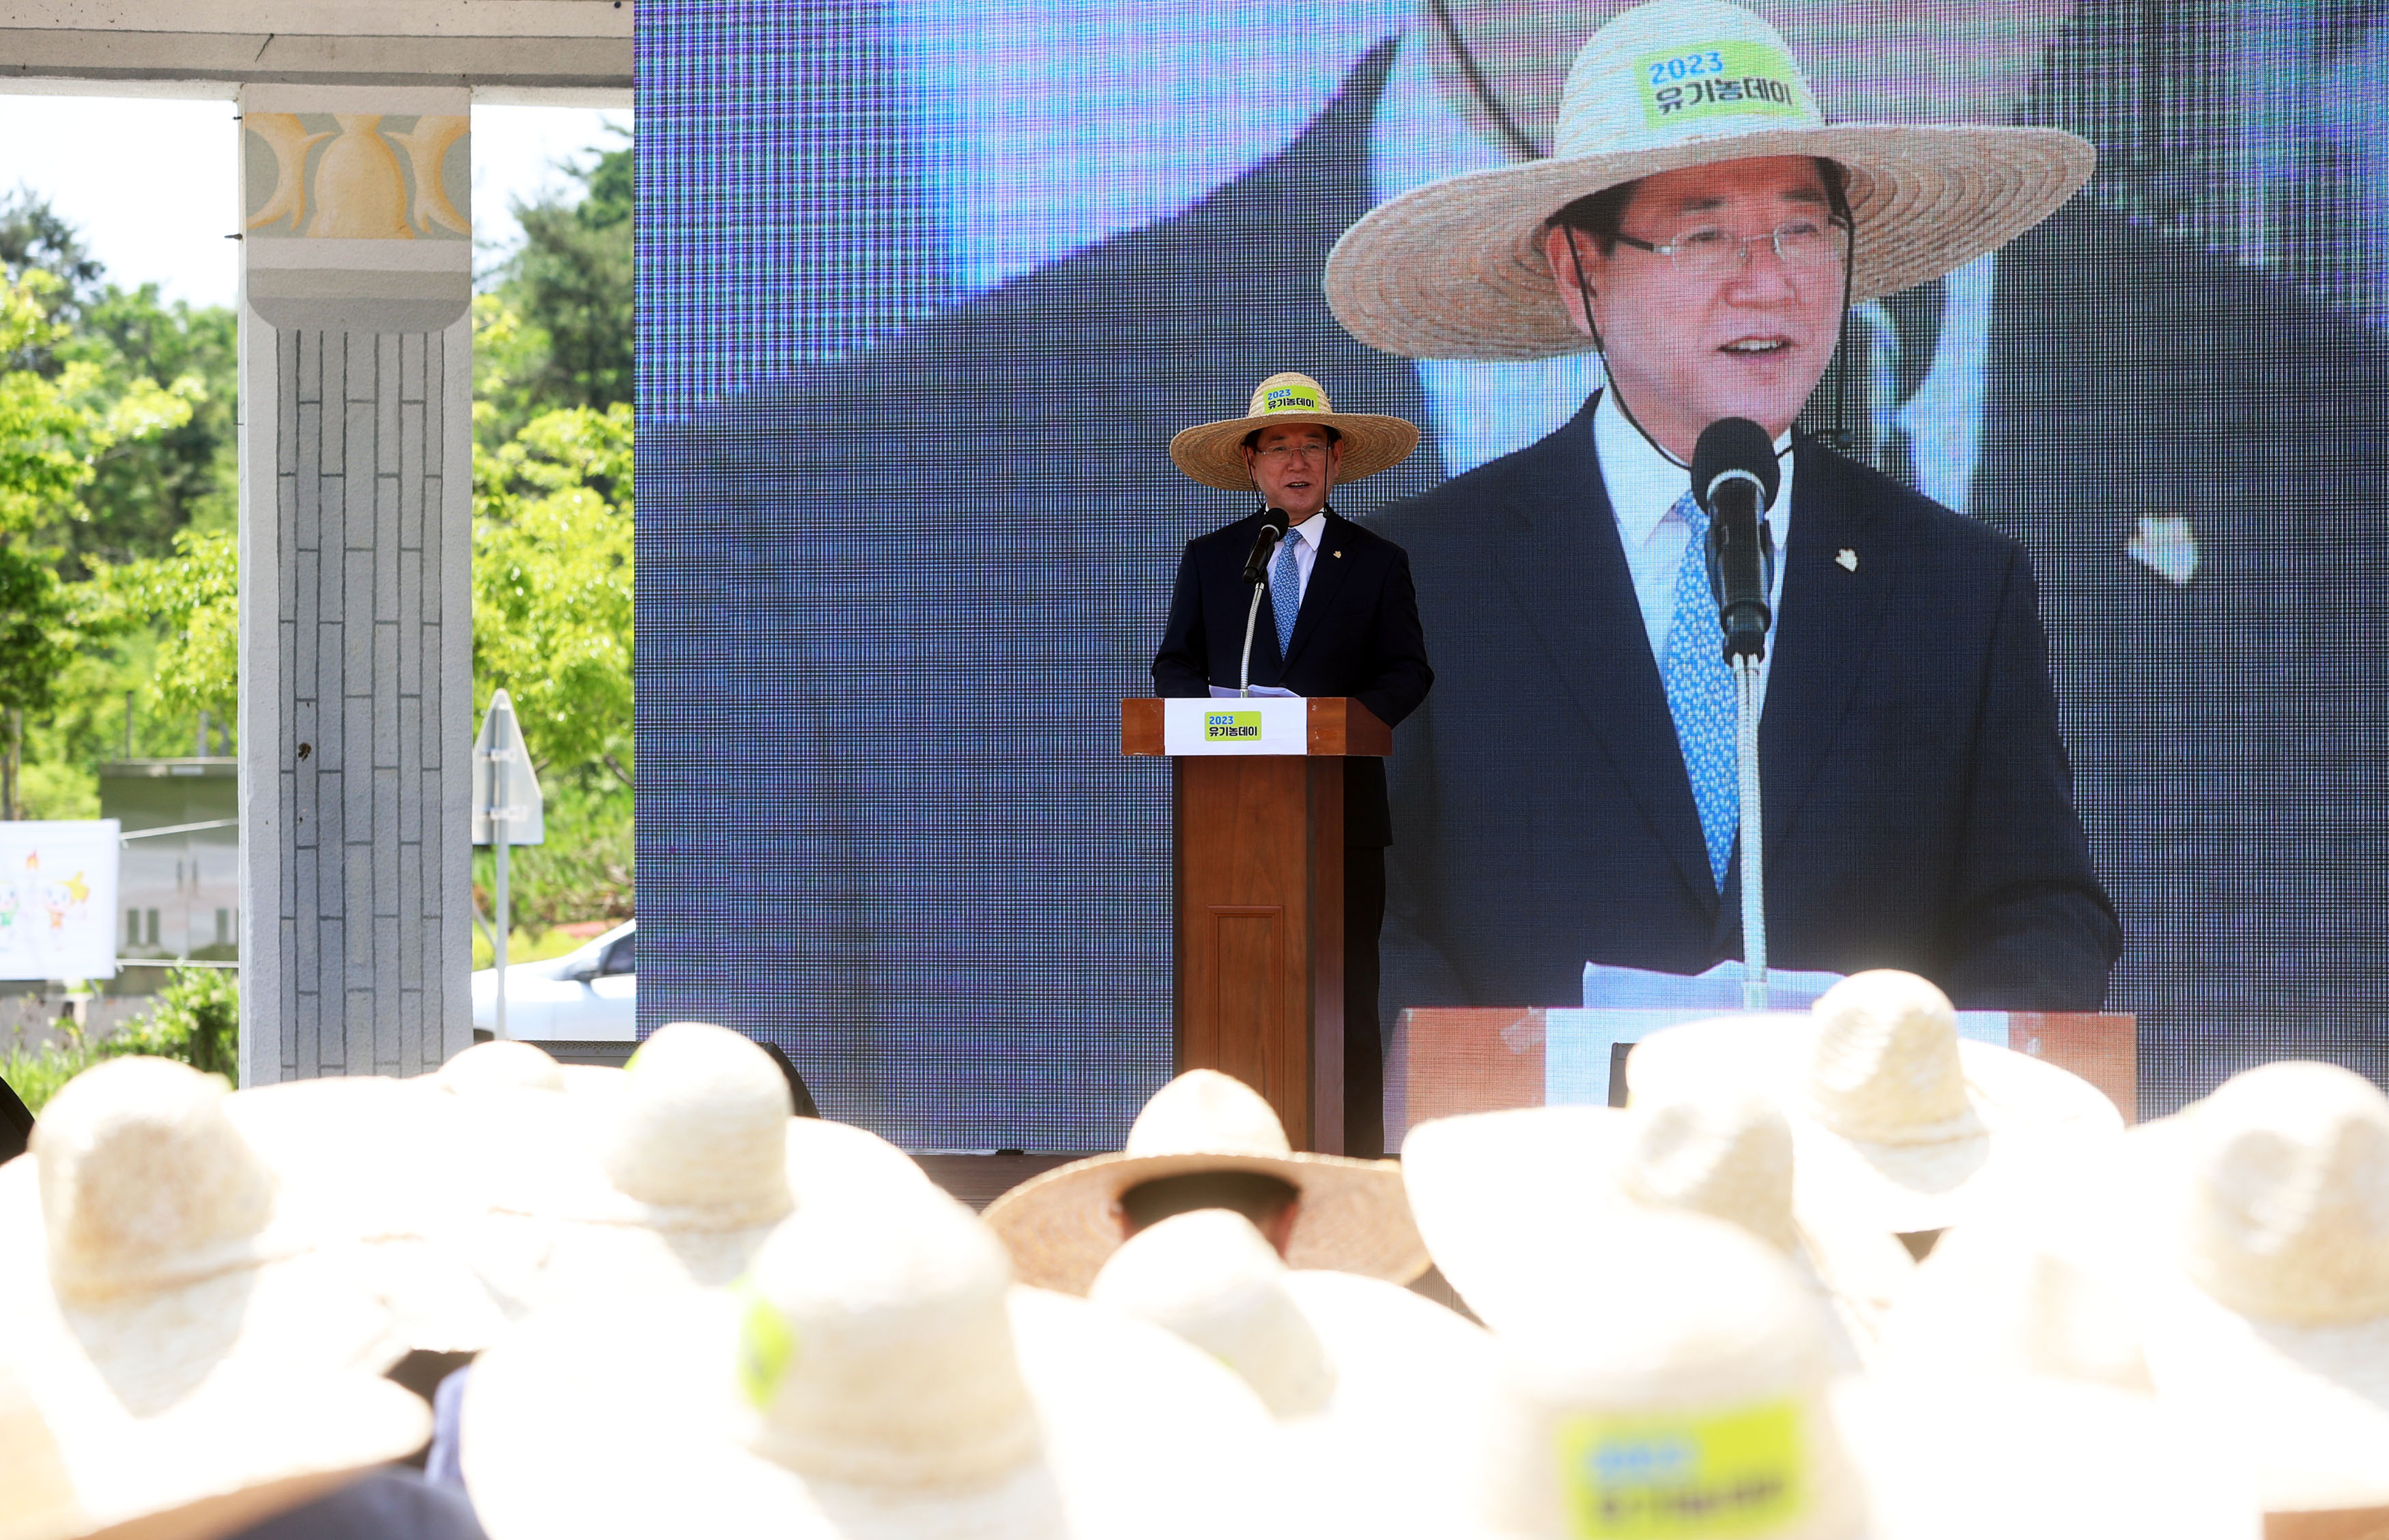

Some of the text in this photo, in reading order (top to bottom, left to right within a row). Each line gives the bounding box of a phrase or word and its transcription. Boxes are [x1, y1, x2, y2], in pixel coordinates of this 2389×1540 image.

[1649, 52, 1723, 85] 2023
[1655, 76, 1793, 115] 유기농데이
[1268, 389, 1291, 400] 2023
[1268, 397, 1314, 410] 유기농데이
[1209, 716, 1234, 725] 2023
[1209, 726, 1257, 737] 유기농데이
